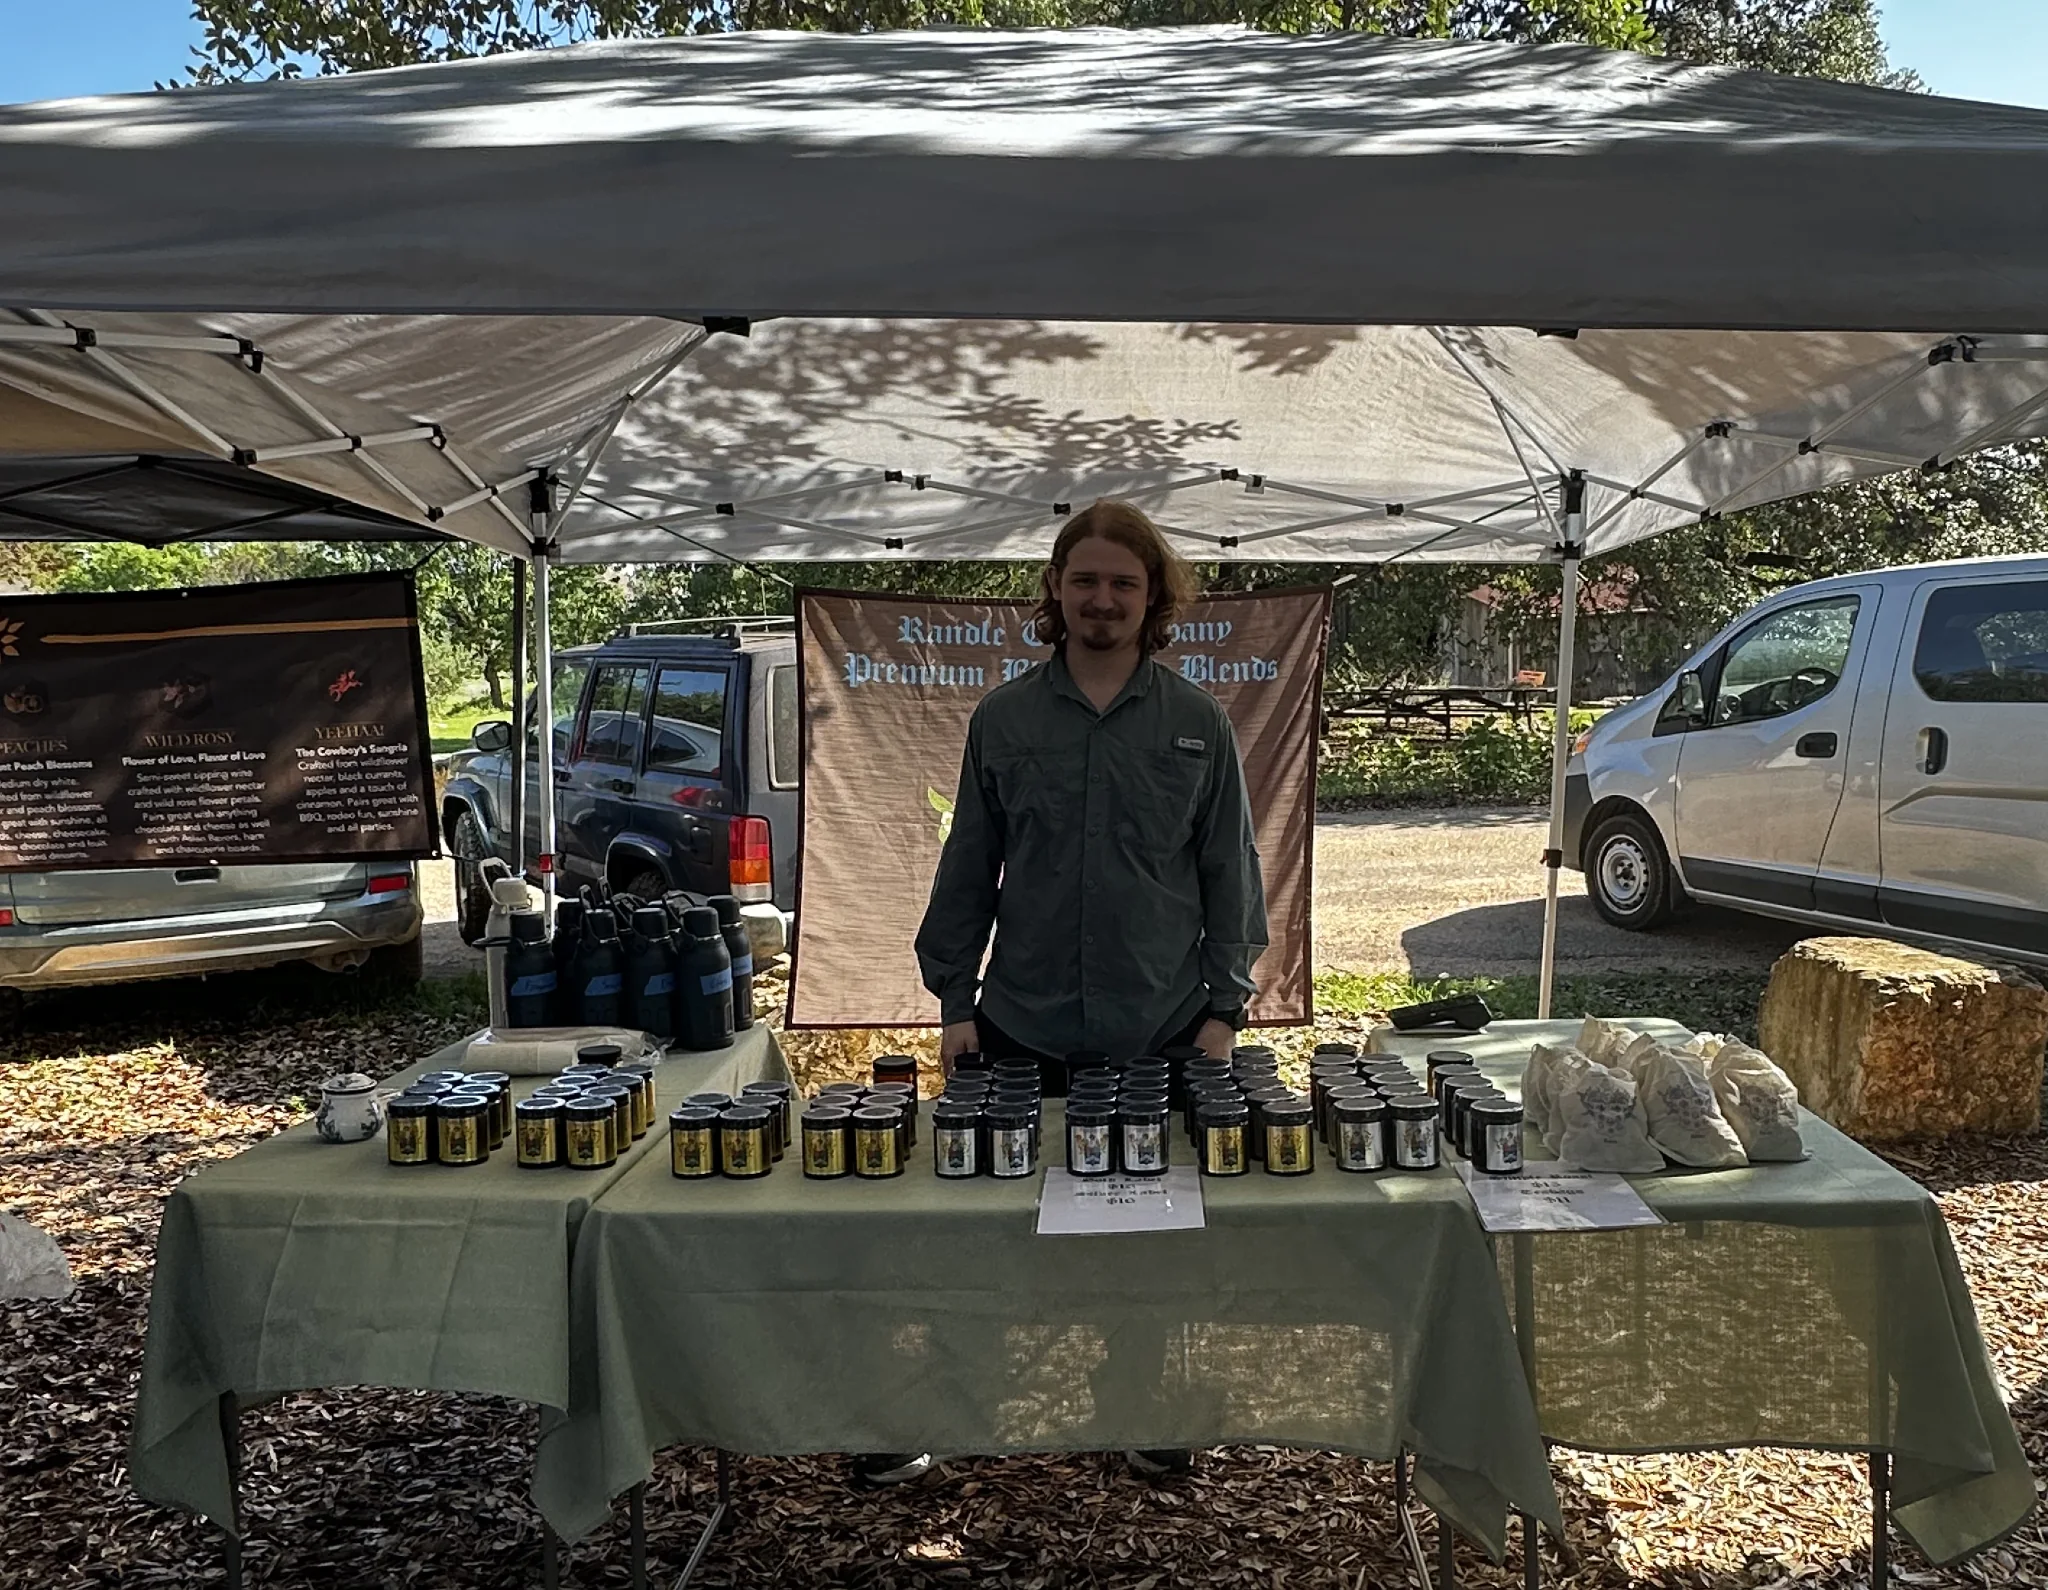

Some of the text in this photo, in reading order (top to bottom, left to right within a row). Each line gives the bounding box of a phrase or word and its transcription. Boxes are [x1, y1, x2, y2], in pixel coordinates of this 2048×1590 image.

[897, 615, 1006, 646] Randle
[842, 652, 985, 688] Premium
[1179, 654, 1279, 684] Blends
[144, 731, 234, 747] WILD ROSY
[295, 748, 315, 757] The
[317, 745, 367, 757] Cowboy's
[122, 757, 155, 767] Flower
[158, 755, 169, 764] of
[199, 752, 229, 762] Flavor
[230, 751, 241, 761] of
[242, 751, 266, 760] Love
[297, 759, 335, 770] Crafted
[336, 759, 359, 768] from
[14, 760, 44, 771] Peach
[46, 760, 93, 770] Blossoms
[0, 778, 31, 789] edium
[339, 784, 358, 794] and
[396, 781, 407, 791] of
[398, 793, 419, 803] with
[327, 823, 345, 833] and
